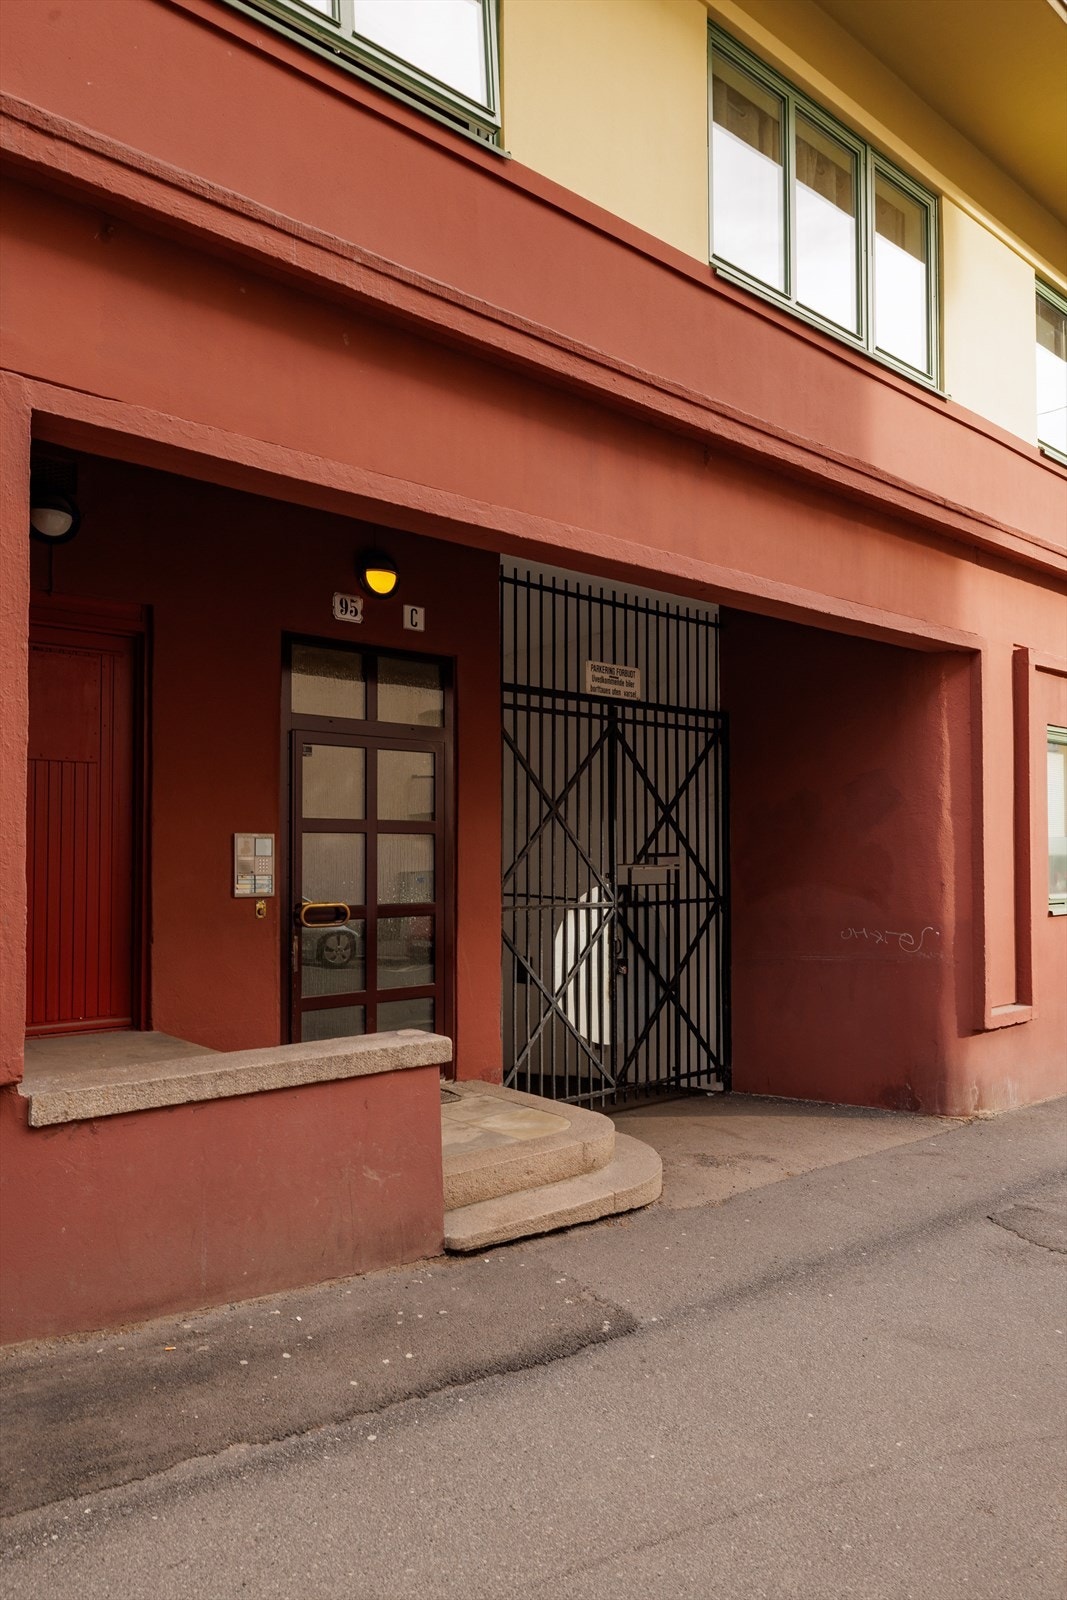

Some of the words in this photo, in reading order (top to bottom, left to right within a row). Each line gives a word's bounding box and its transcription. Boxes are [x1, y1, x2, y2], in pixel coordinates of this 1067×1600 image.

[339, 597, 359, 618] 95
[410, 607, 418, 628] C
[591, 664, 615, 675] PARKERING
[616, 668, 635, 679] FORBUDT
[592, 675, 624, 686] Uvedkommende
